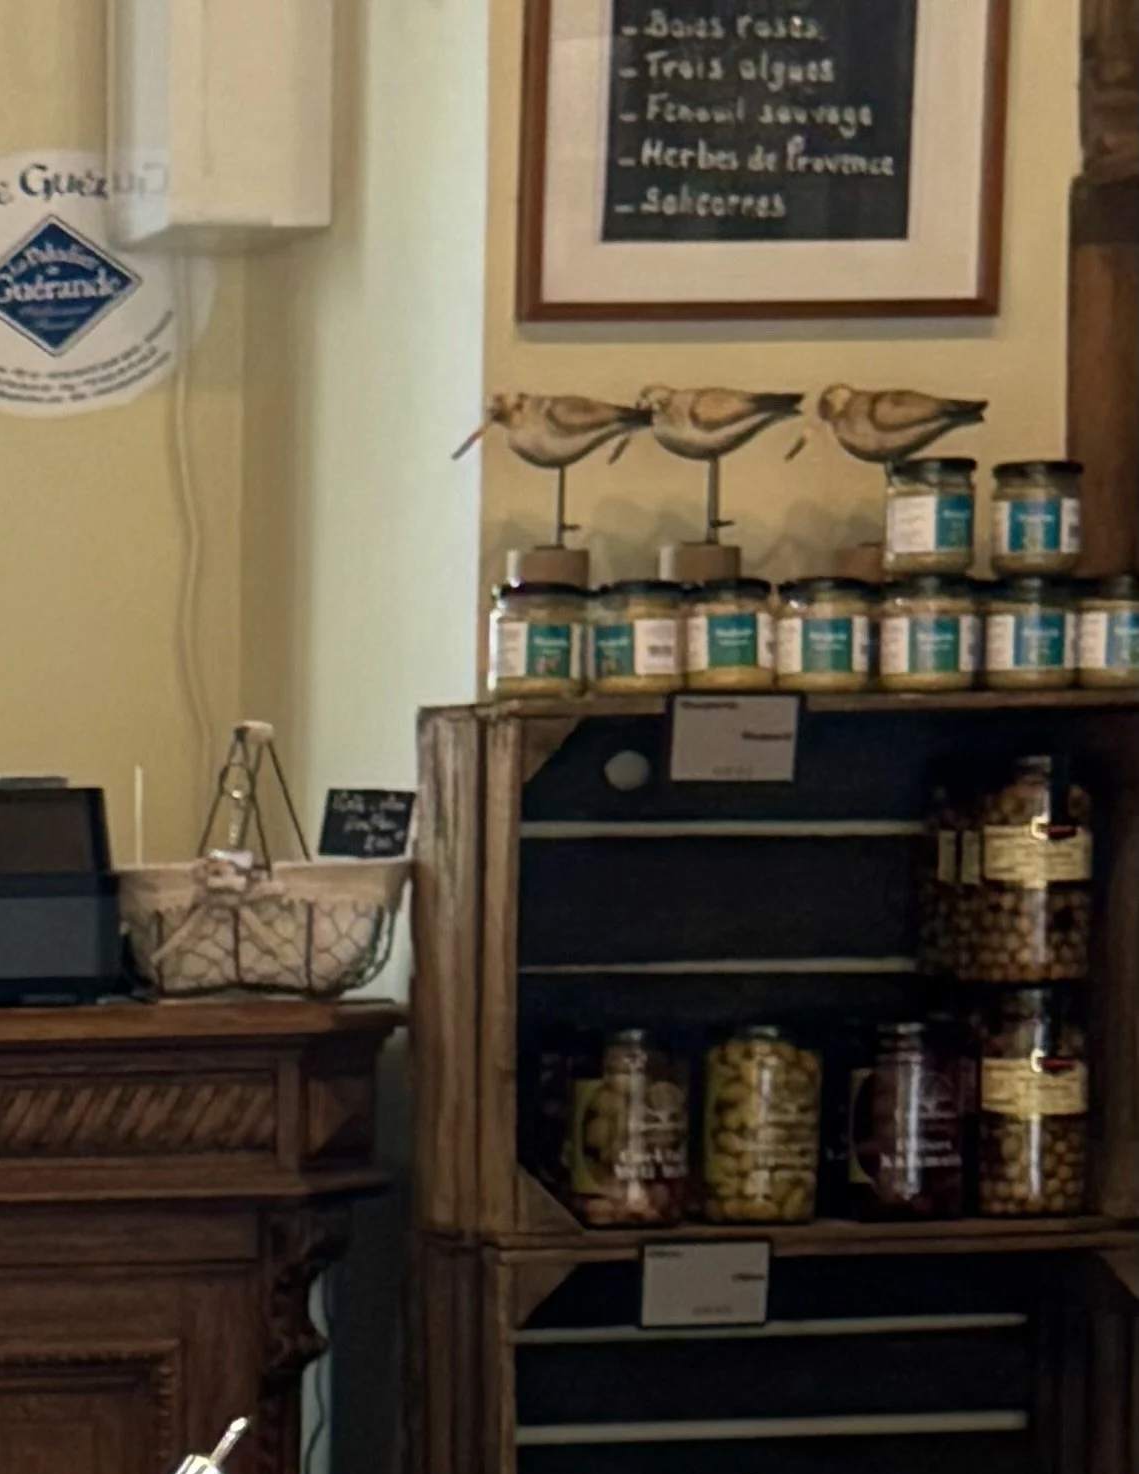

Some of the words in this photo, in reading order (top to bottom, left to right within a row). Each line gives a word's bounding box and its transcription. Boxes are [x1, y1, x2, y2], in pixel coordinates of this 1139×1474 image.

[644, 50, 724, 80] Trois
[739, 51, 835, 92] algues
[641, 138, 739, 171] Herbes
[748, 144, 779, 173] de
[786, 134, 895, 176] Provence
